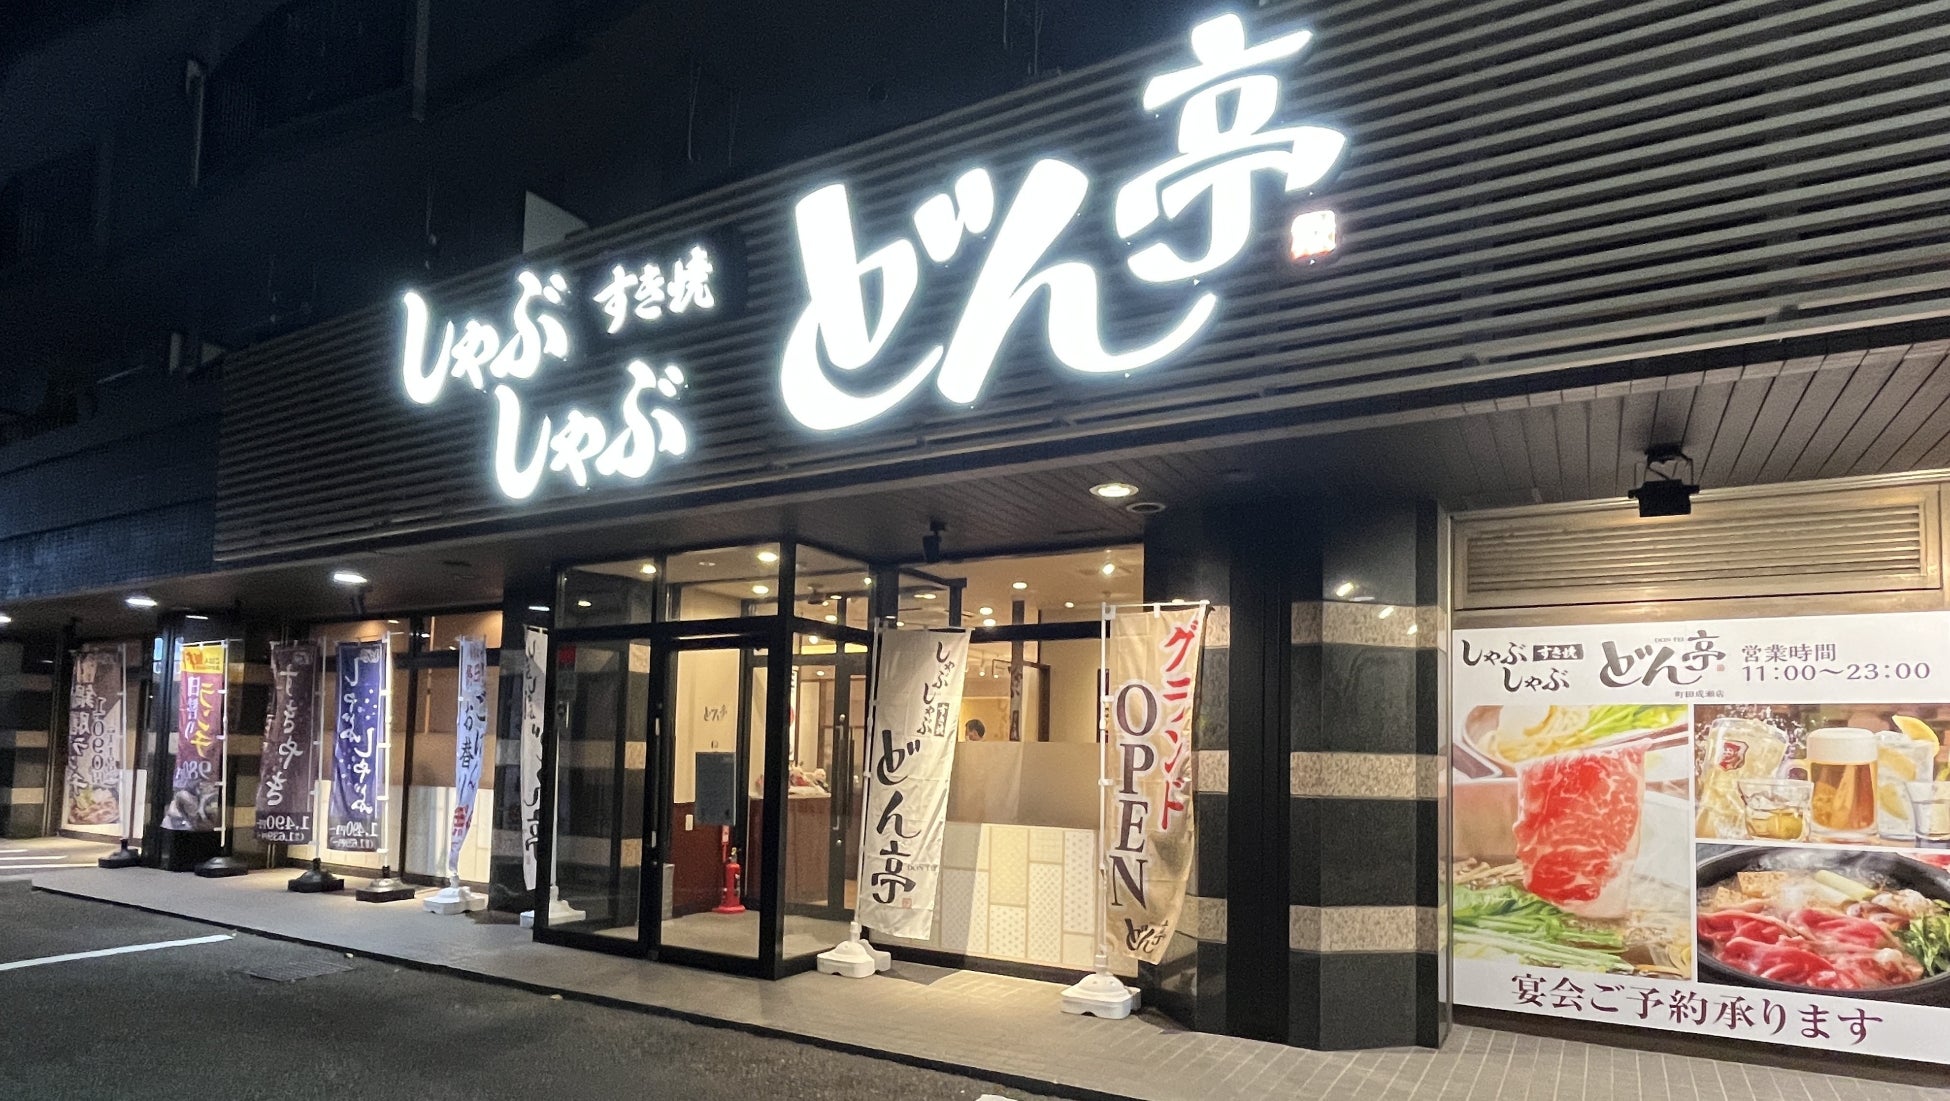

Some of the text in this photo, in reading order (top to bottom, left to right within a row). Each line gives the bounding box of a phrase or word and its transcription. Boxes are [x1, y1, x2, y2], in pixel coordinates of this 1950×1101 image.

[780, 13, 1346, 430] どん亭
[594, 245, 715, 334] すき焼
[403, 271, 570, 404] しゃぶ
[495, 359, 687, 499] しゃぶ
[932, 642, 955, 688] しゃぶ
[1461, 639, 1527, 666] しゃぶ
[1503, 667, 1570, 692] しゃぶ
[1535, 645, 1581, 661] すき焼
[1600, 630, 1726, 687] どん亭
[1741, 643, 1837, 664] 営業時間
[917, 683, 936, 735] しゃぶ
[1163, 620, 1198, 830] グランド
[871, 730, 921, 904] どん亭
[1109, 684, 1157, 909] OPEN
[1511, 973, 1883, 1046] 宴会ご予約承ります
